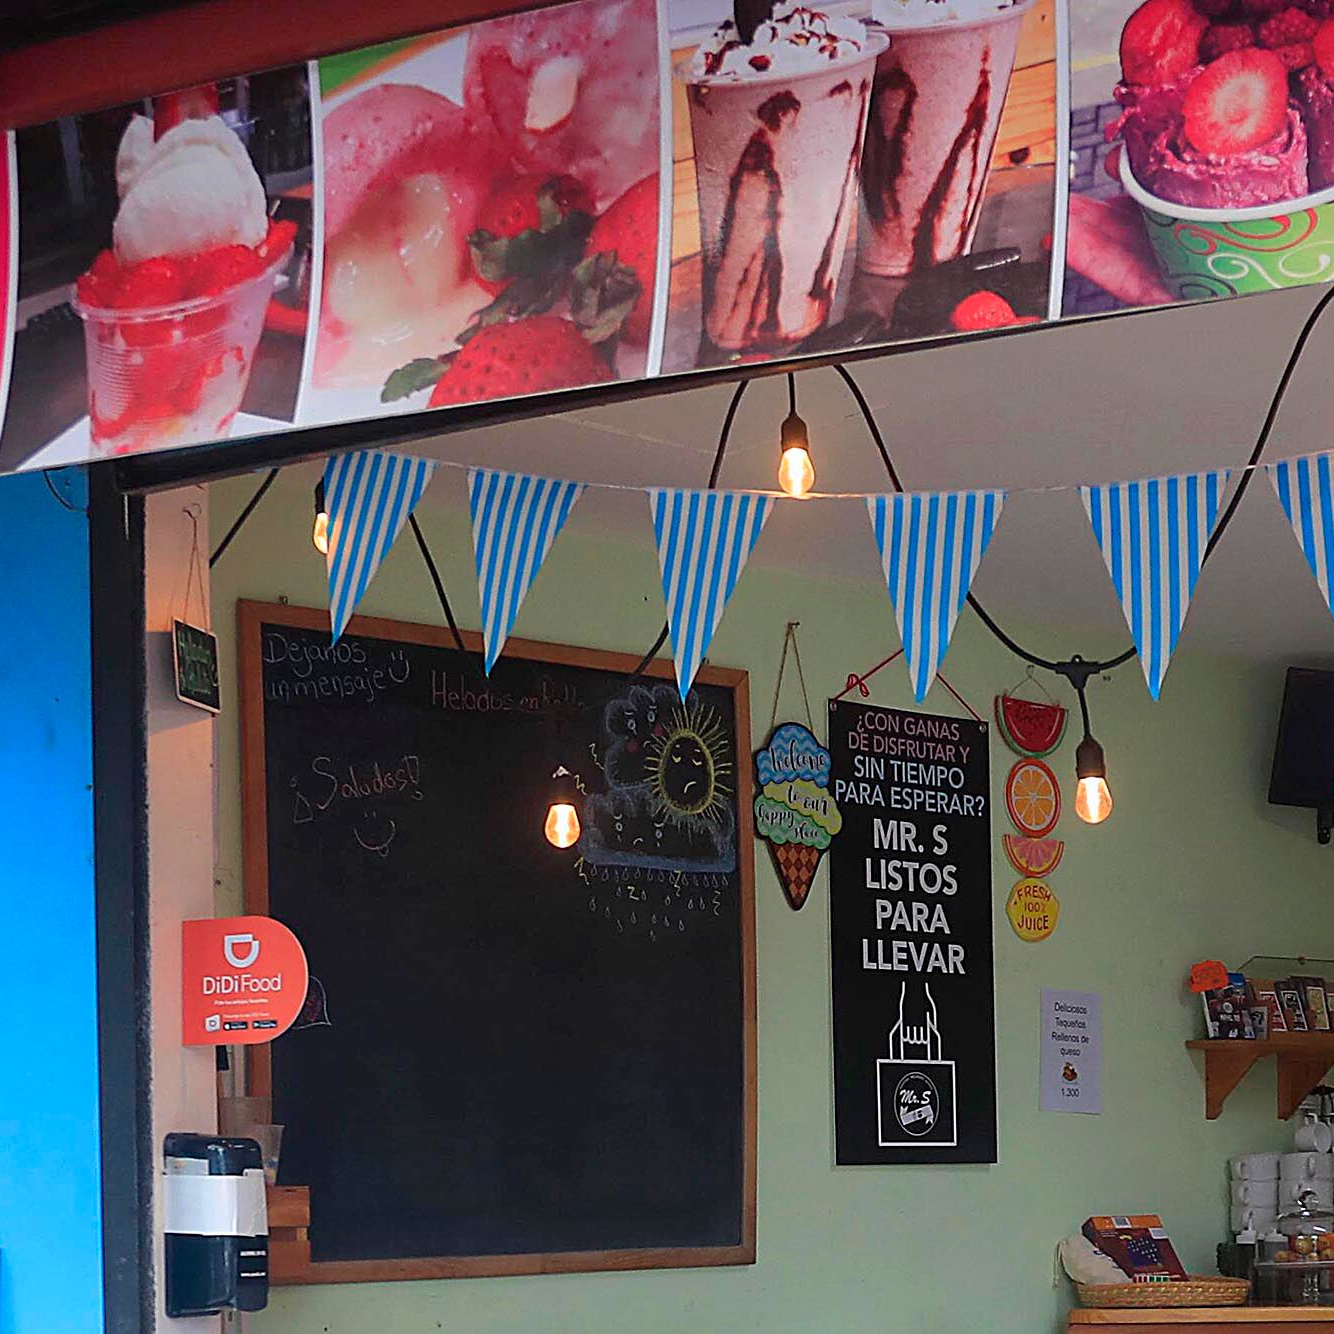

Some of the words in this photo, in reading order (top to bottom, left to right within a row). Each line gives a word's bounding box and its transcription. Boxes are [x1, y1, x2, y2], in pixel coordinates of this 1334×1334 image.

[293, 669, 384, 702] mensaje
[857, 712, 899, 733] ¿CON
[904, 716, 960, 741] GANAS
[848, 732, 868, 750] DE
[874, 735, 955, 762] DISFRUTAR
[959, 746, 969, 764] Y
[854, 755, 884, 781] SIN
[890, 760, 964, 788] TIEMPO
[835, 780, 885, 807] PARA
[891, 787, 984, 817] ESPERAR?
[873, 818, 924, 852] MR.
[932, 824, 948, 855] S
[866, 858, 958, 895] LISTOS
[1017, 885, 1052, 901] FRESH
[876, 899, 951, 934] PARA
[1017, 915, 1049, 930] JUICE
[862, 938, 966, 974] LLEVAR
[1060, 1047, 1080, 1057] queso
[1081, 1035, 1089, 1044] de
[920, 1090, 931, 1105] S
